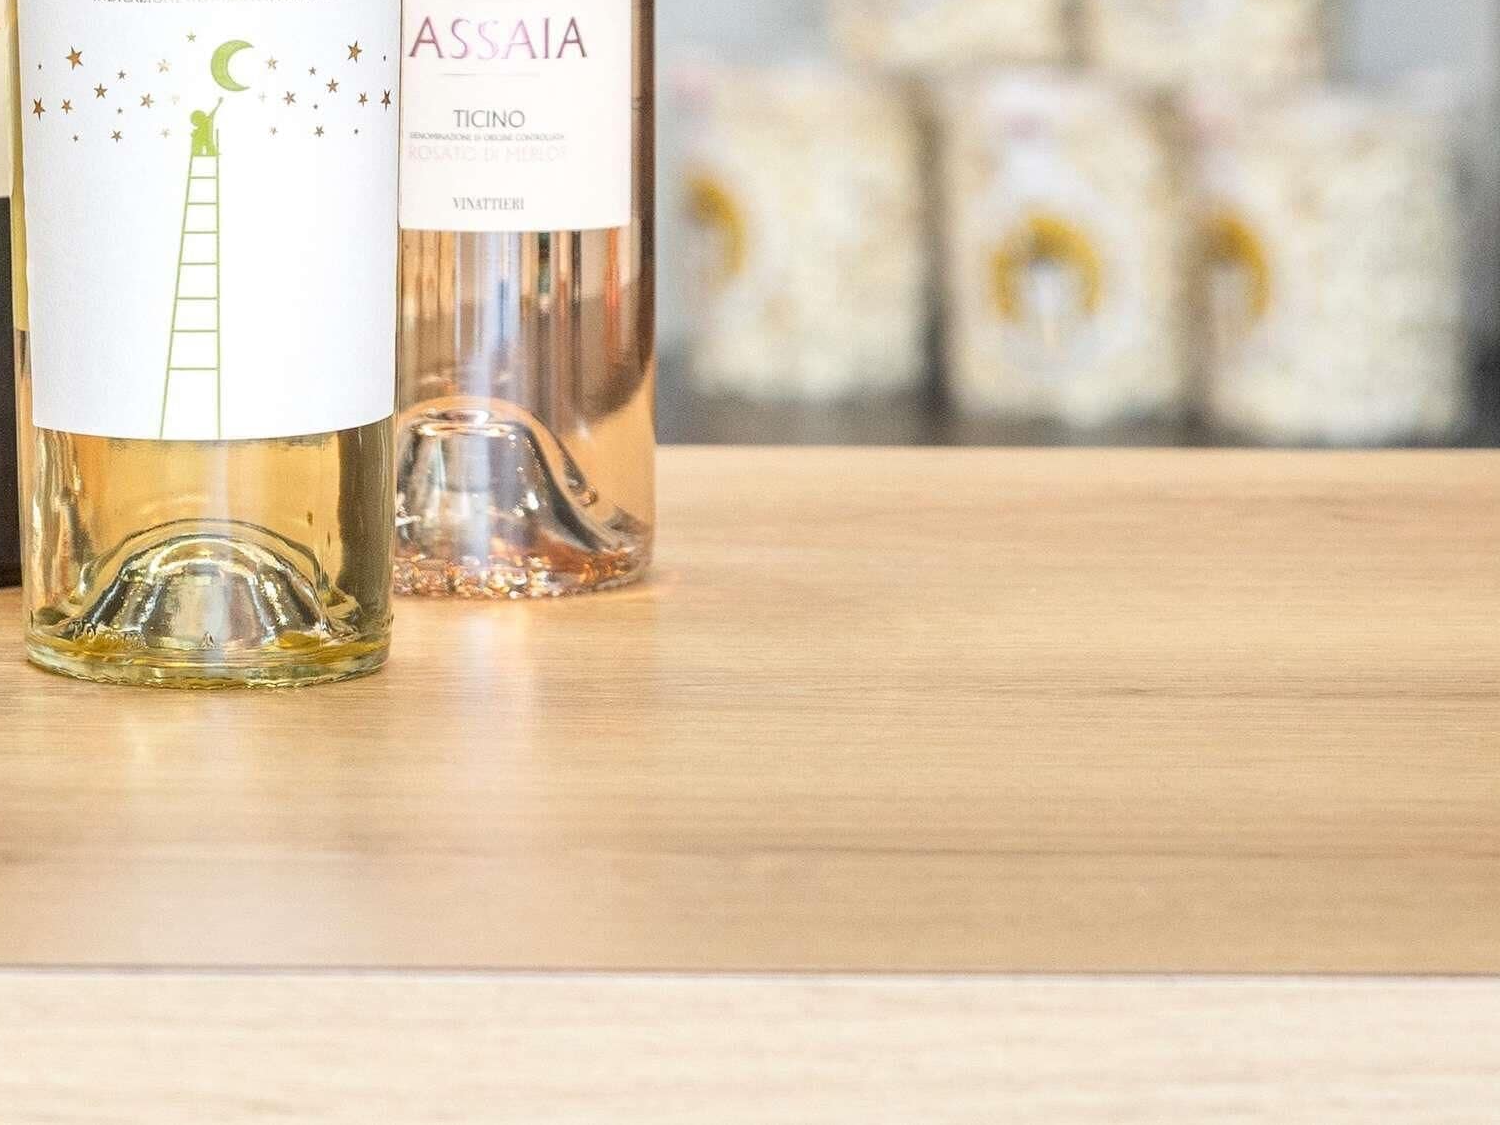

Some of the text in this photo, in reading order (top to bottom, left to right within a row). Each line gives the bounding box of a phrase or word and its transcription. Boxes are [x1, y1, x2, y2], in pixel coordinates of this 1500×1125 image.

[408, 16, 588, 60] ASSAIA
[452, 109, 526, 128] TICINO
[452, 196, 525, 211] VINATTIERI
